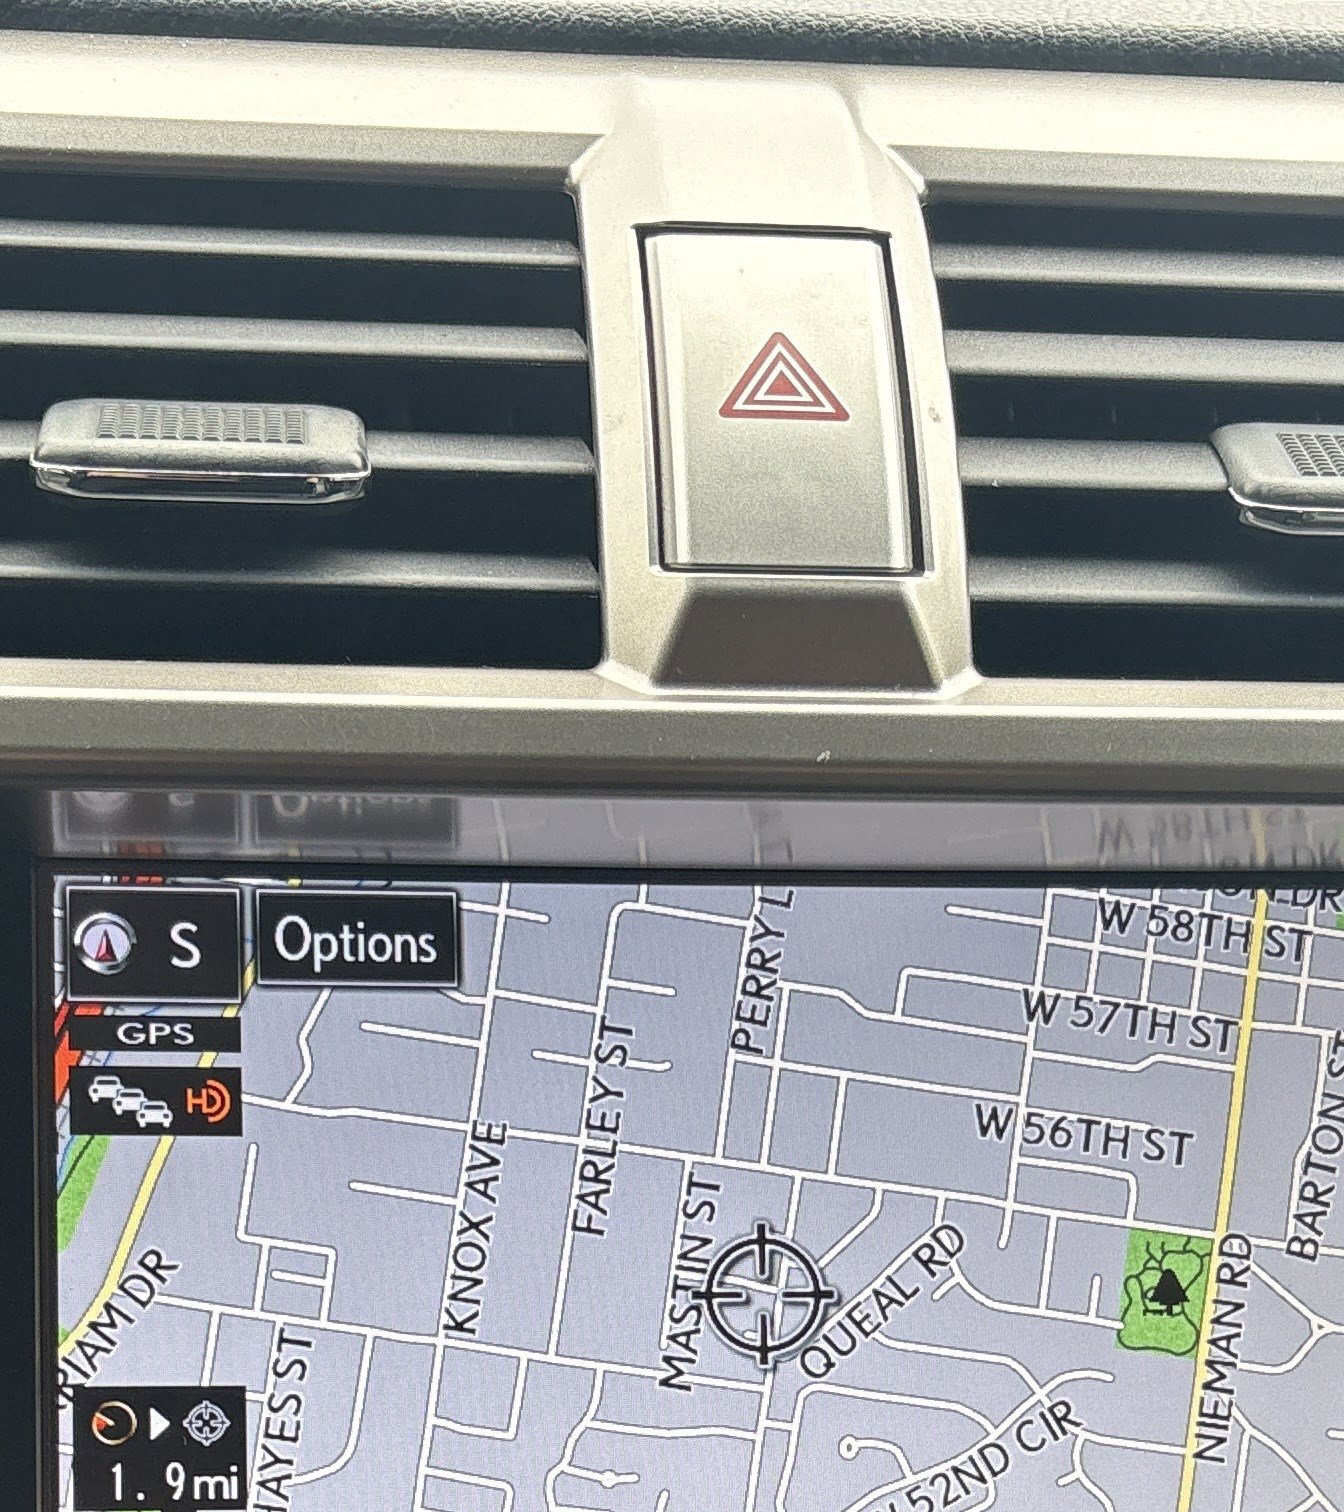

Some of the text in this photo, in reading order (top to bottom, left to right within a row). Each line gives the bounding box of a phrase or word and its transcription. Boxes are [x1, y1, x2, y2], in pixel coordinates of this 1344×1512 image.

[169, 922, 202, 969] S
[274, 915, 438, 972] Options
[1100, 899, 1312, 962] W 58TH ST
[732, 916, 786, 1054] PERRY
[116, 1022, 195, 1046] GPS
[1022, 988, 1240, 1053] W 57TH ST
[573, 1014, 635, 1236] FARLEY ST
[976, 1104, 1194, 1166] W 56TH ST
[443, 1120, 508, 1335] KNOX AVE
[659, 1172, 722, 1391] MASTIN ST
[800, 1223, 966, 1380] QUEAL RD
[58, 1249, 180, 1411] RIAM DR
[273, 1327, 313, 1380] ST
[1194, 1233, 1253, 1463] NIEMAN RD
[1015, 1399, 1084, 1453] CIR
